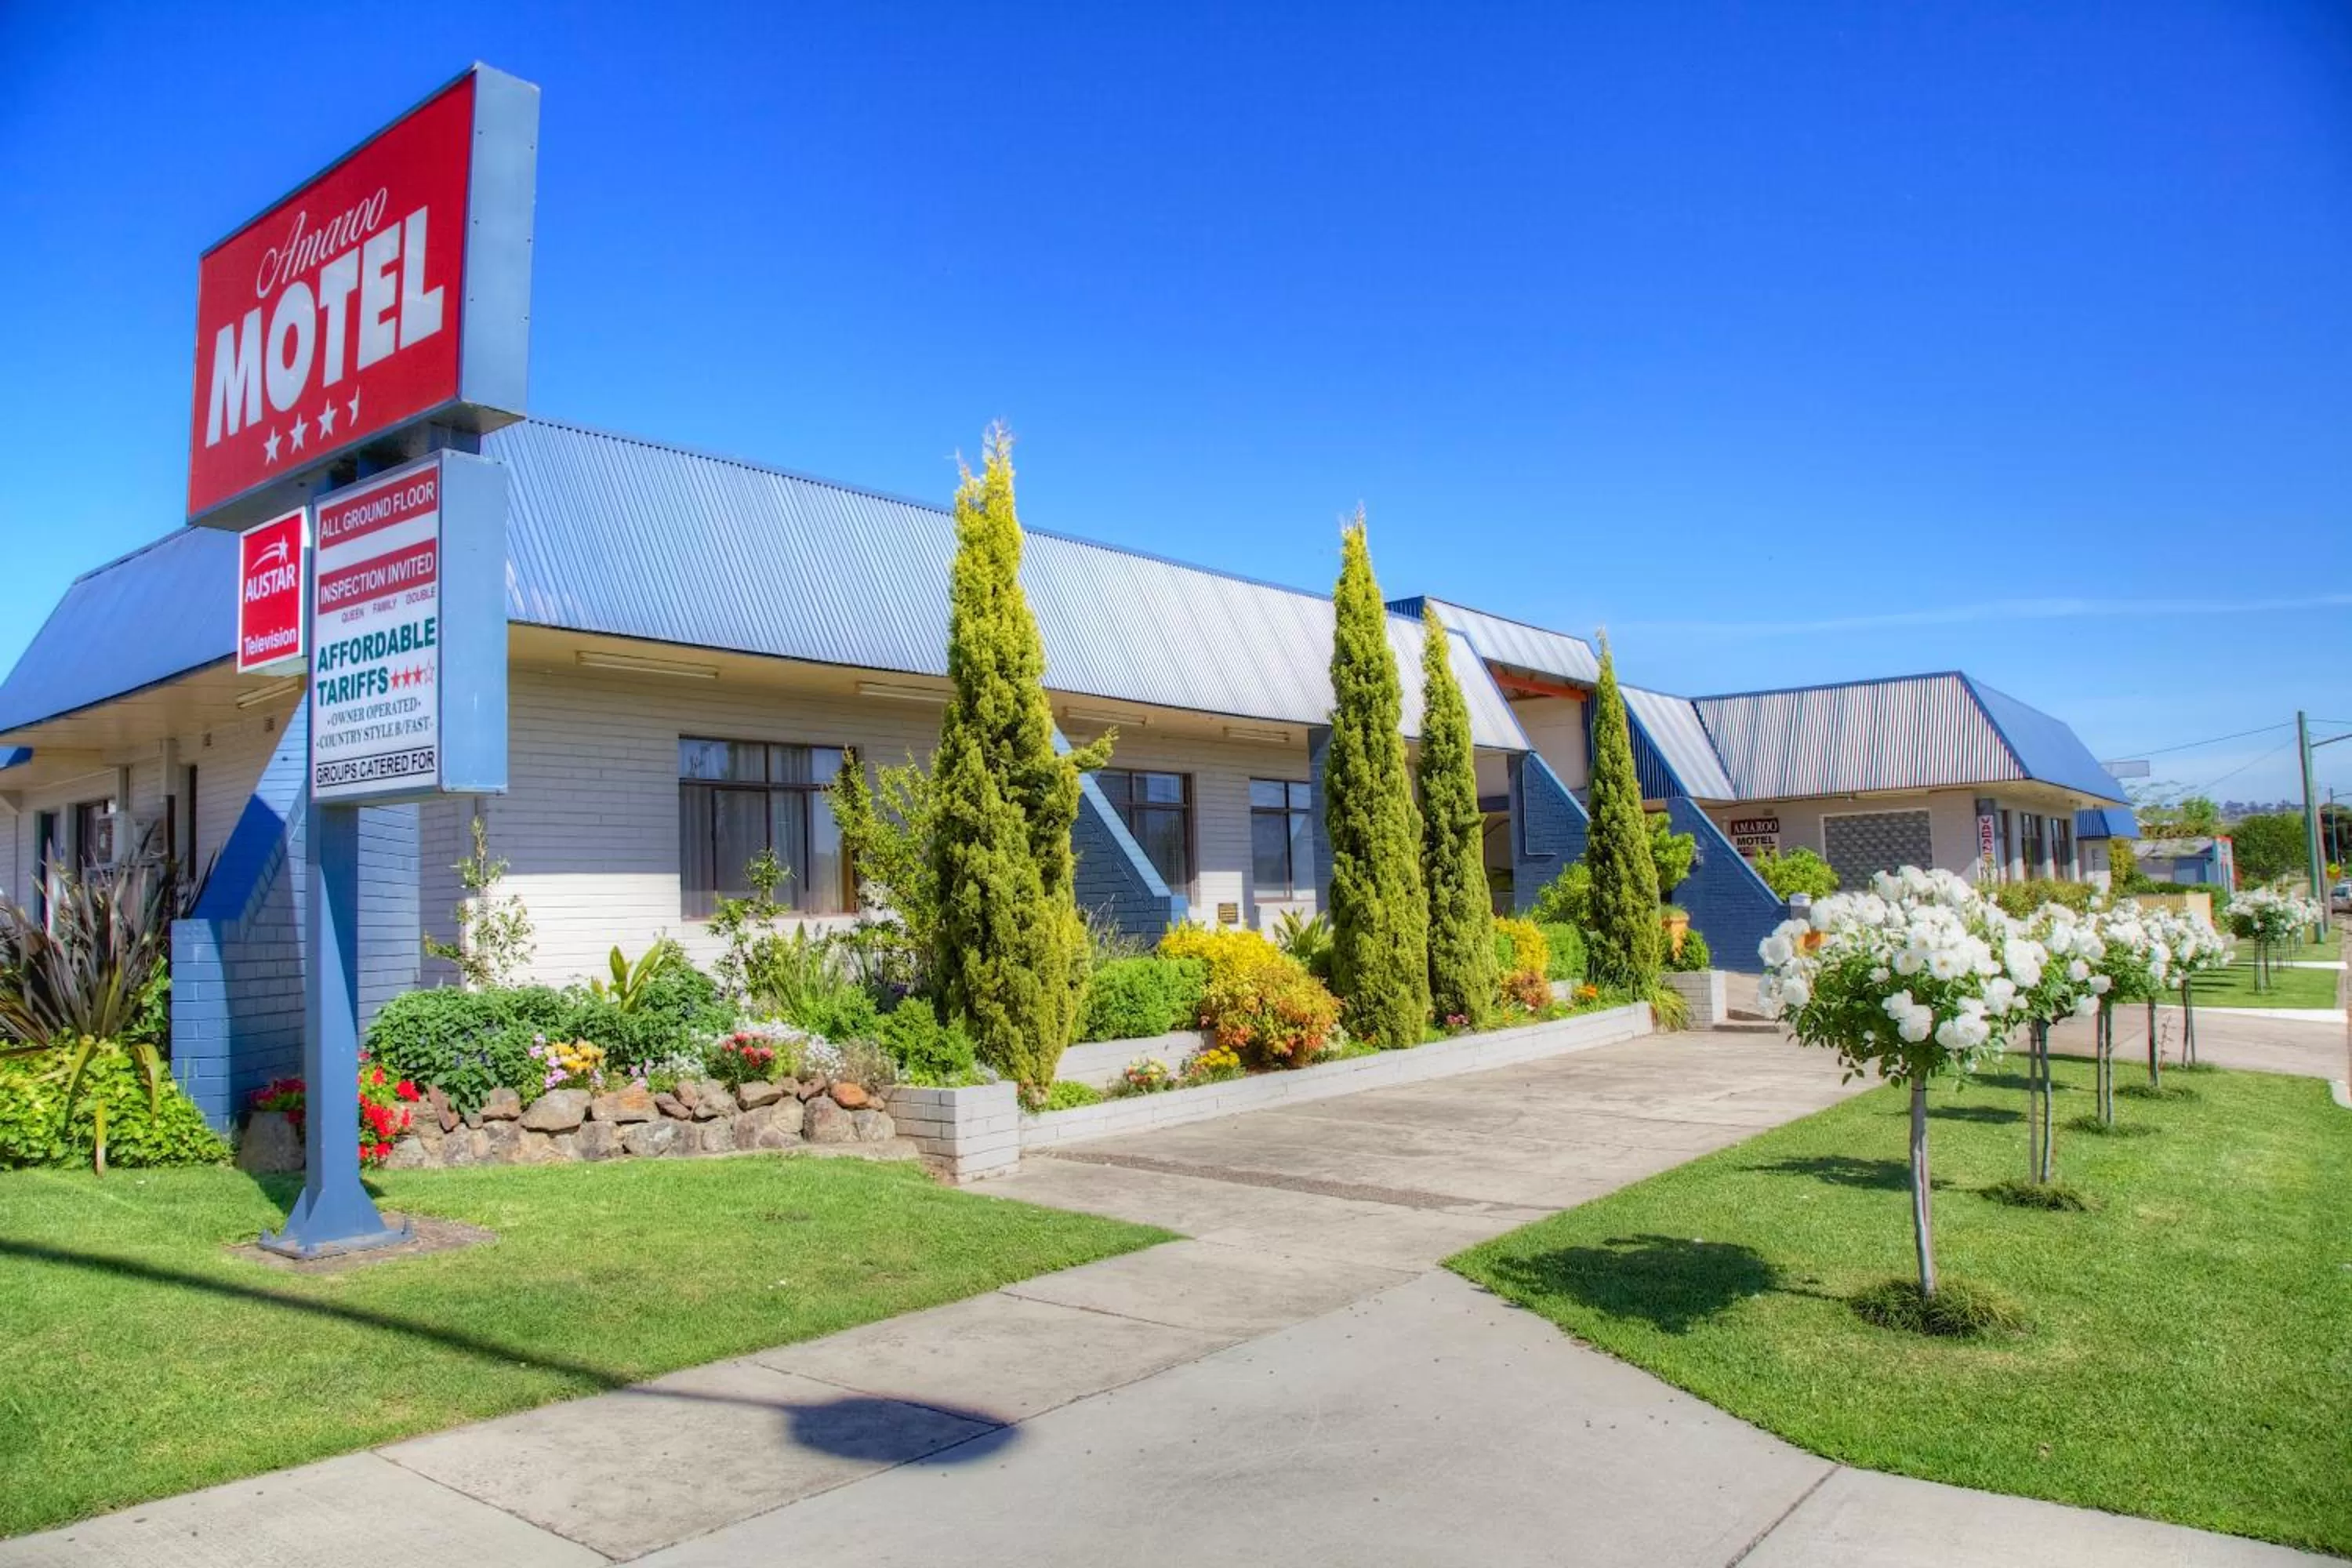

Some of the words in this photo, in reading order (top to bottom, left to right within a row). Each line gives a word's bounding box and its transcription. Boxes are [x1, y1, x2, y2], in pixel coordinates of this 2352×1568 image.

[256, 187, 387, 299] Amaroo
[205, 205, 445, 448] MOTEL
[321, 517, 342, 540] ALL
[343, 496, 391, 532] GROUND
[393, 481, 435, 514] FLOOR
[244, 563, 296, 603] AUSTAR
[320, 567, 386, 604] INSPECTION
[388, 551, 434, 584] INVITED
[341, 608, 365, 623] QUEEN
[372, 598, 397, 614] FAMILY
[405, 586, 436, 604] DOUBLE
[244, 626, 296, 657] Television
[317, 617, 436, 673] AFFORDABLE
[317, 666, 388, 706] TARIFFS
[331, 707, 365, 727] OWNER
[366, 696, 418, 720] OPERATED
[319, 728, 362, 750] COUNTRY
[363, 723, 394, 741] STYLE
[316, 762, 358, 784] GROUPS
[359, 755, 409, 778] CATERED
[411, 750, 435, 770] FOR
[1733, 820, 1778, 834] AMAROO
[1737, 836, 1776, 846] MOTEL
